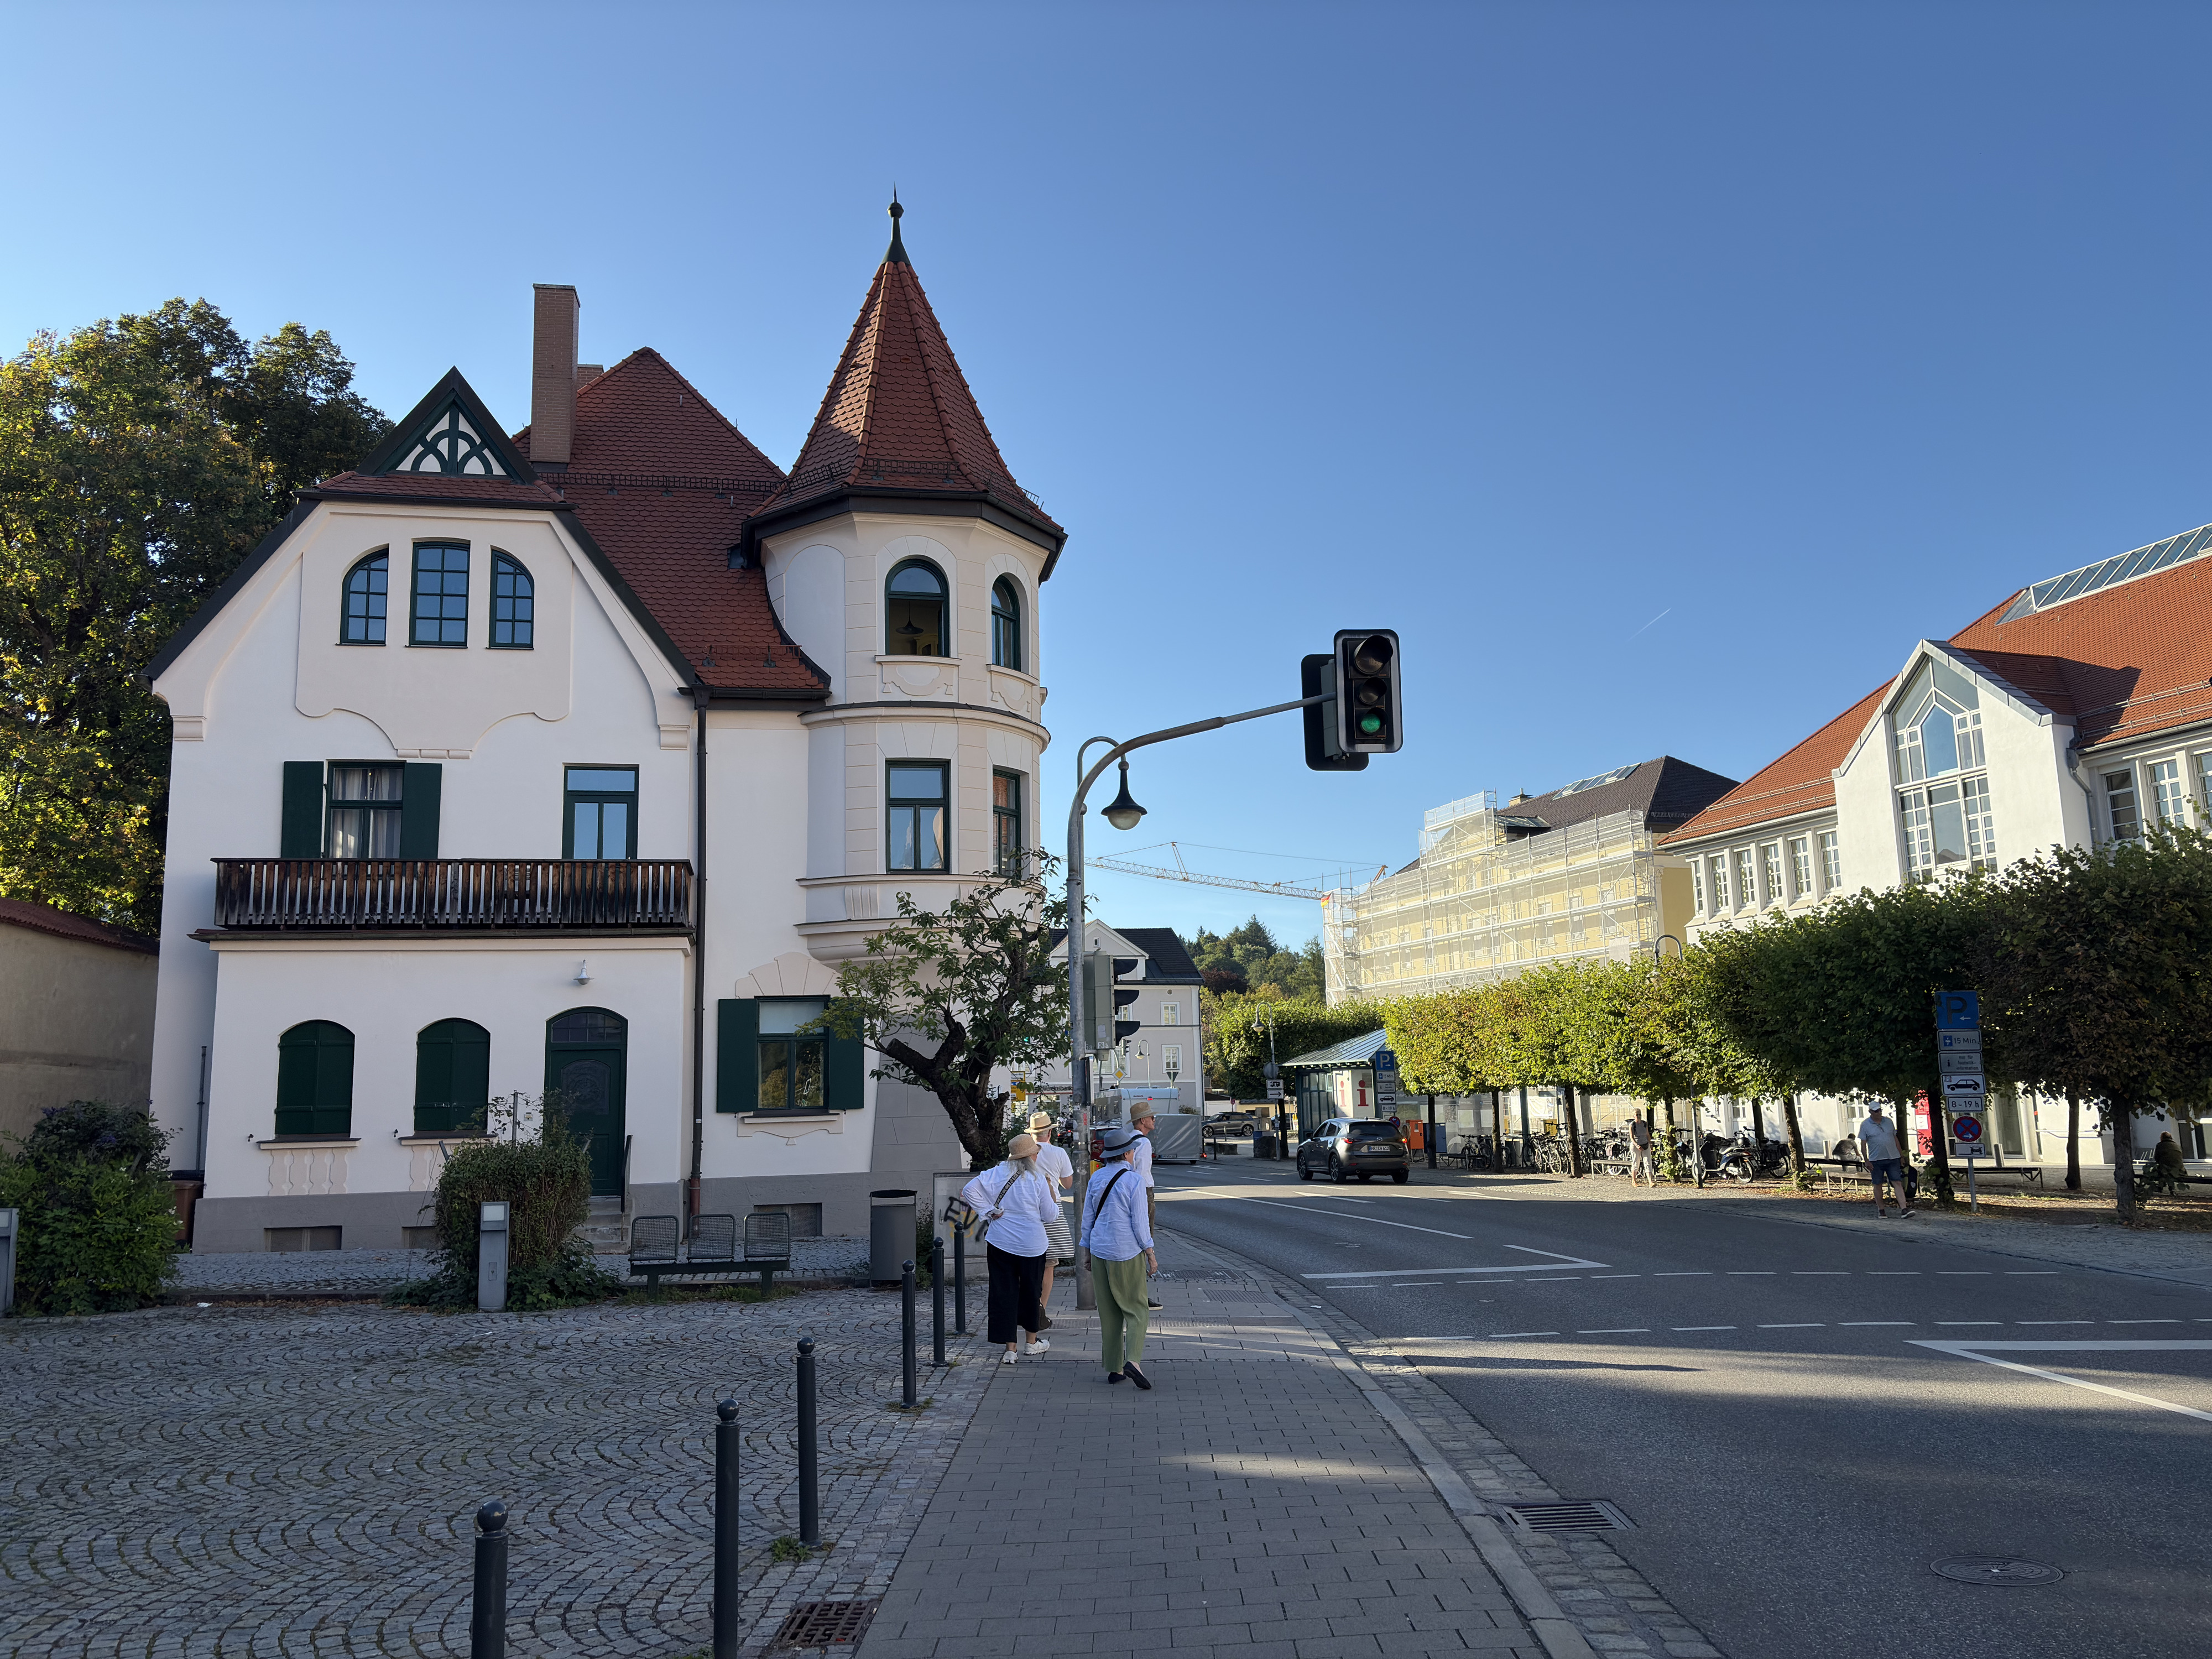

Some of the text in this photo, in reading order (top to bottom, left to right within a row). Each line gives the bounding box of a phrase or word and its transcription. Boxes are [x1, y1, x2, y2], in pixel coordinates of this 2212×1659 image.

[1946, 997, 1968, 1024] P
[1380, 1053, 1390, 1068] P
[1357, 1079, 1369, 1107] i
